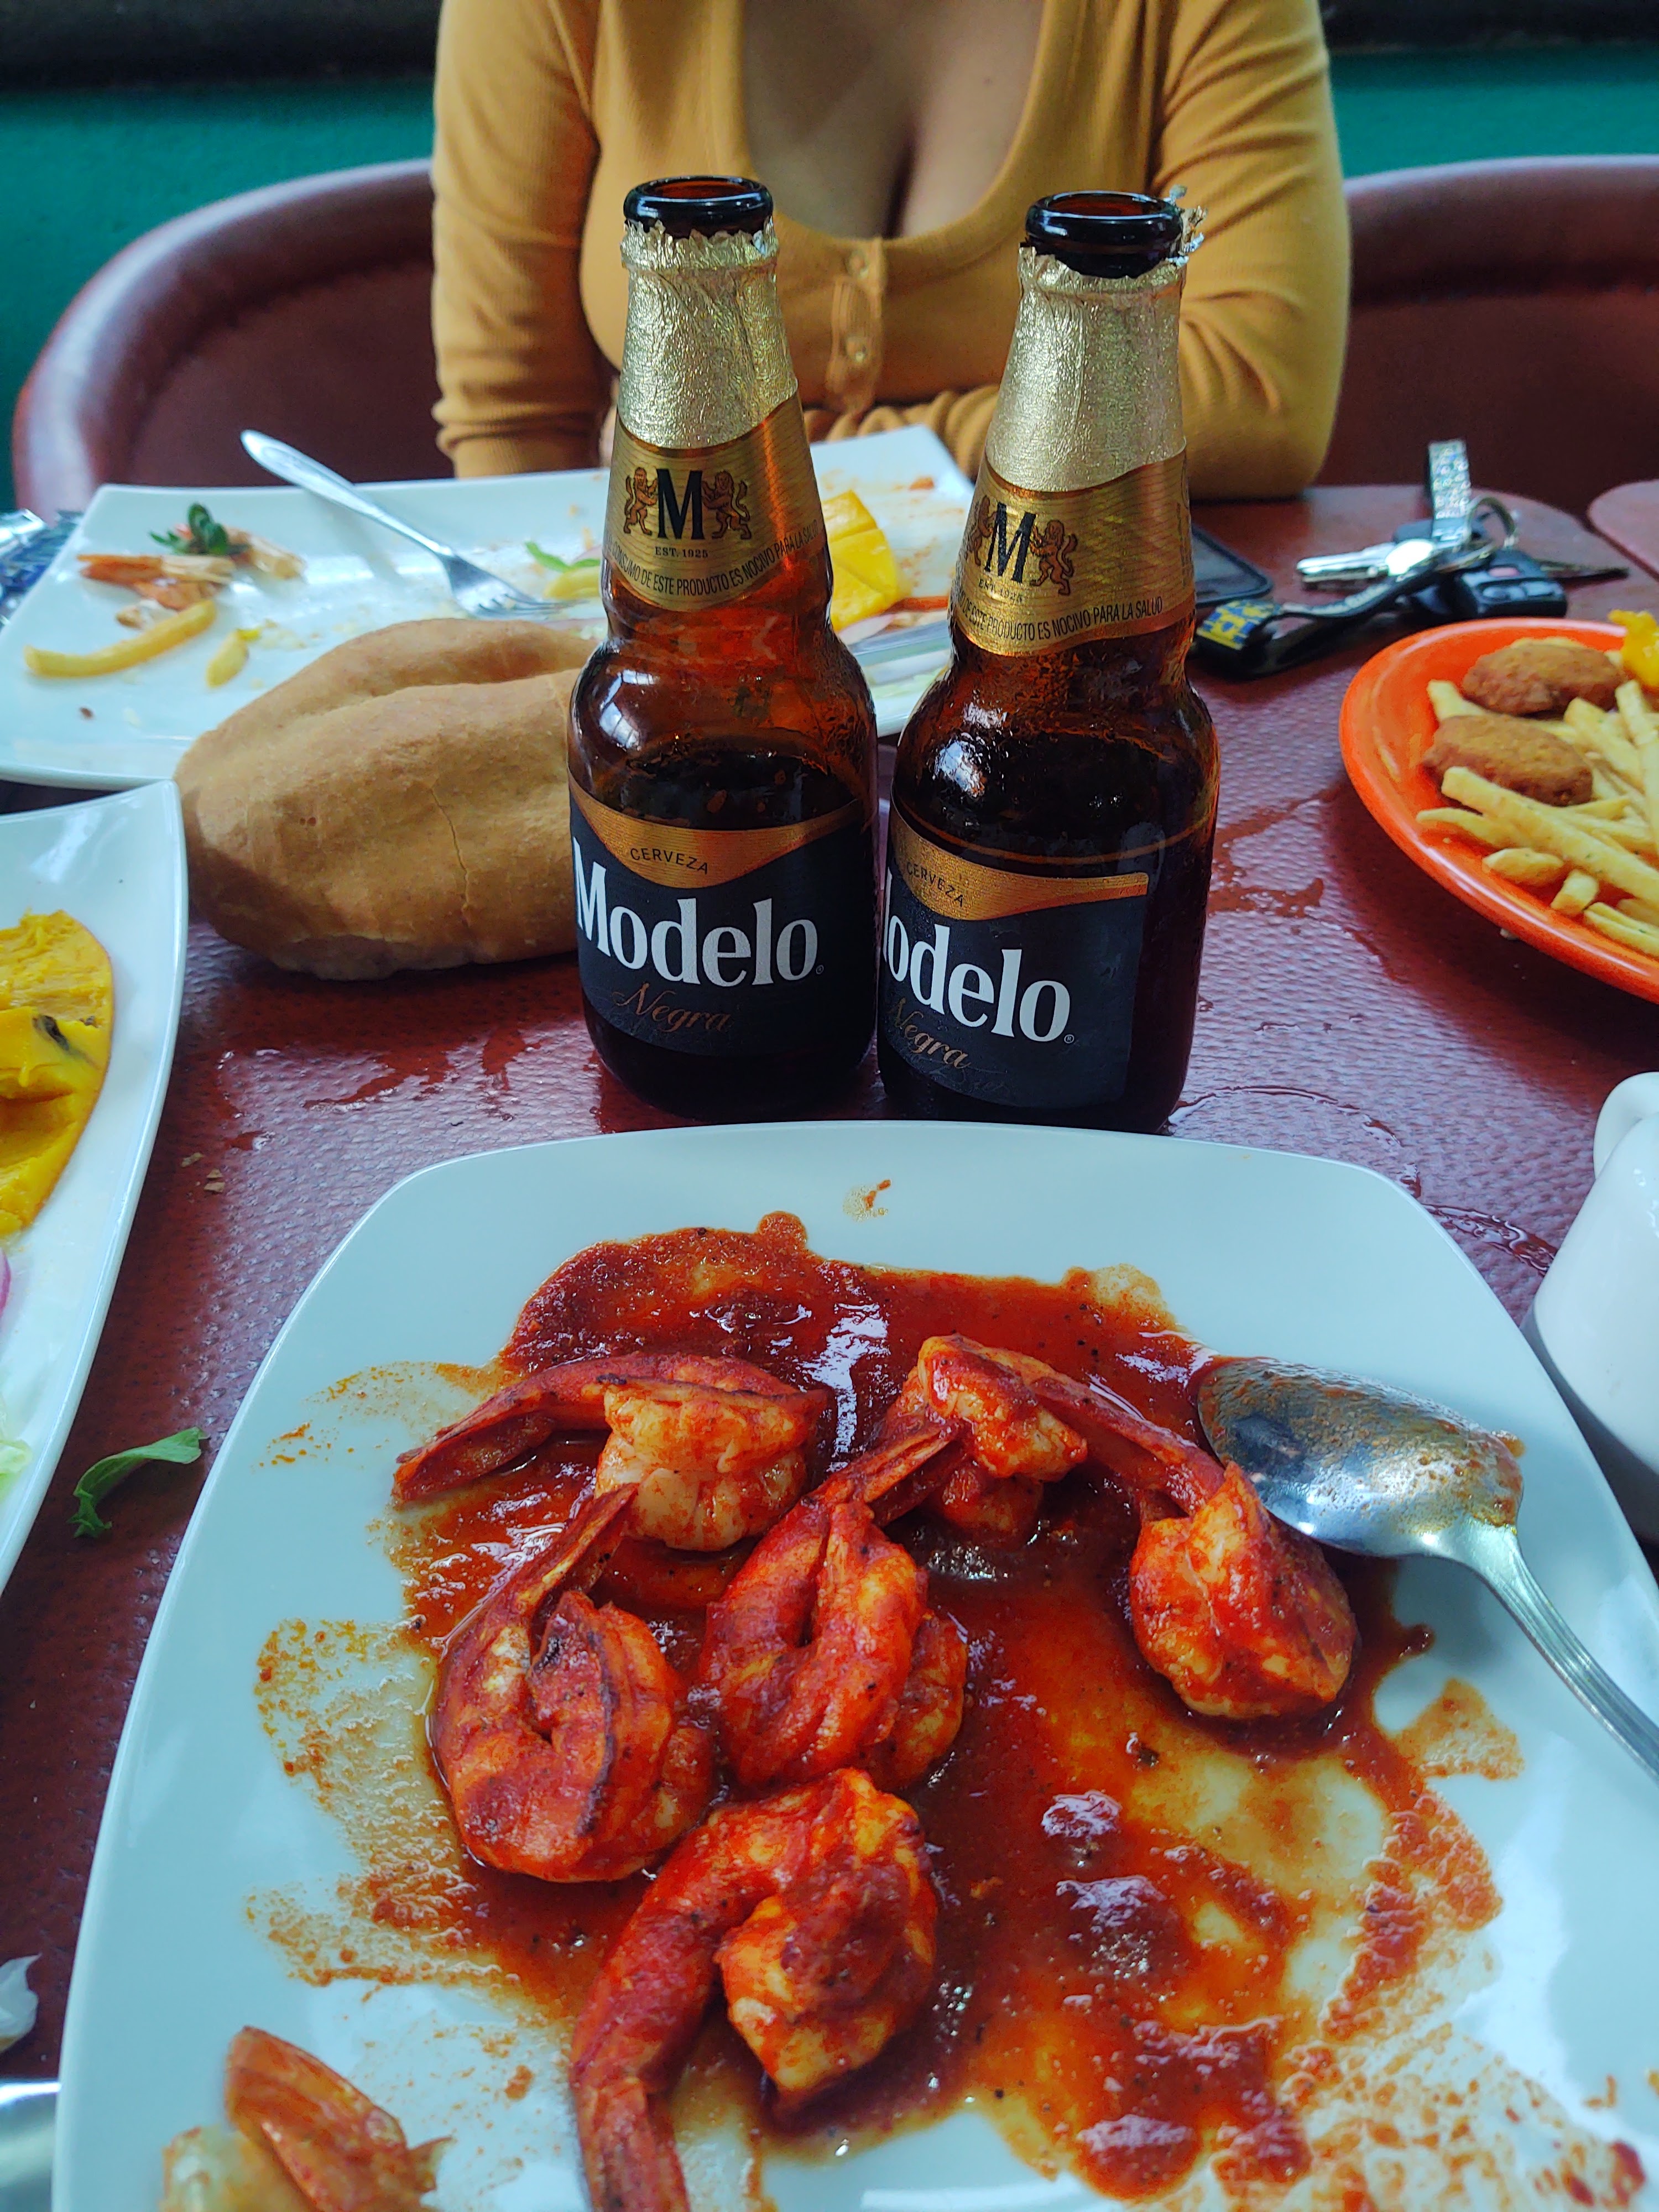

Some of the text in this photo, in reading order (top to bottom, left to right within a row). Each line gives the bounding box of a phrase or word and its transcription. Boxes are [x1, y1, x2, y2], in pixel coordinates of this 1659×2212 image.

[656, 469, 705, 540] M
[612, 541, 641, 581] CONSUMO
[641, 569, 653, 588] DE
[653, 574, 675, 594] ESTE
[676, 573, 729, 597] PRODUCTO
[728, 567, 744, 587] ES
[742, 547, 775, 580] NOCIVO
[774, 537, 795, 559] PARA
[794, 531, 805, 549] LA
[655, 546, 679, 557] EST.
[984, 502, 1036, 583] M
[969, 606, 987, 630] ESTE
[987, 615, 1035, 641] PRODUCTO
[1037, 621, 1051, 640] ES
[1051, 609, 1091, 637] NOCIVO
[1093, 603, 1120, 624] PARA
[1121, 602, 1134, 620] LA
[1135, 596, 1163, 619] SALUD
[630, 847, 709, 875] CERVEZA
[906, 861, 964, 907] CERVEZA
[573, 836, 818, 987] Modelo
[612, 981, 734, 1032] Negra
[887, 996, 972, 1070] Negra
